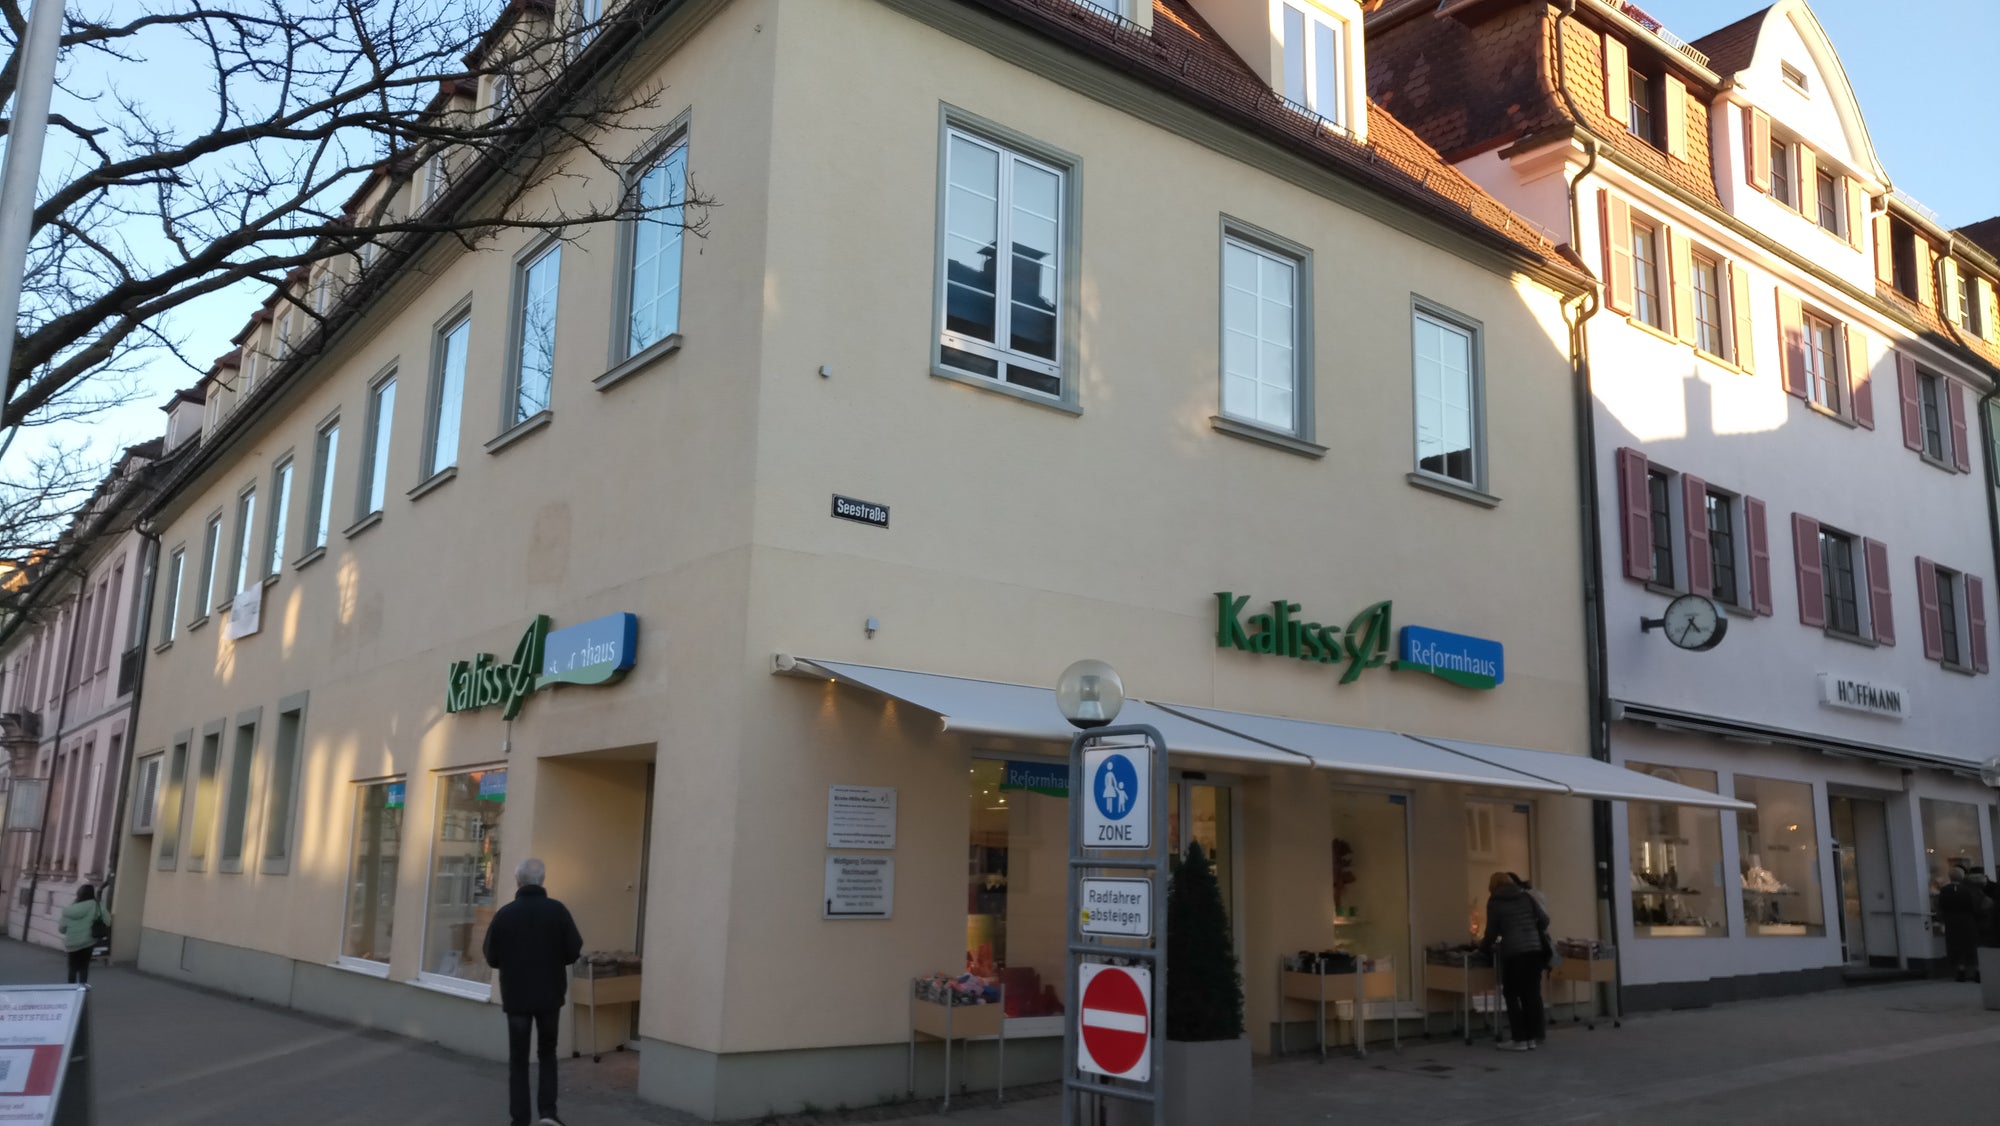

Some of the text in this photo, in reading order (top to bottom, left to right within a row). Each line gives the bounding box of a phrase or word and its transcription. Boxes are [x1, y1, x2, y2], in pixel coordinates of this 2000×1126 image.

[837, 499, 886, 522] Seestraße
[1411, 640, 1496, 677] Reformhaus
[1010, 769, 1069, 791] Reformhau
[1099, 825, 1132, 840] ZONE
[1089, 889, 1142, 904] Radfahrer
[1090, 908, 1142, 926] absteigen
